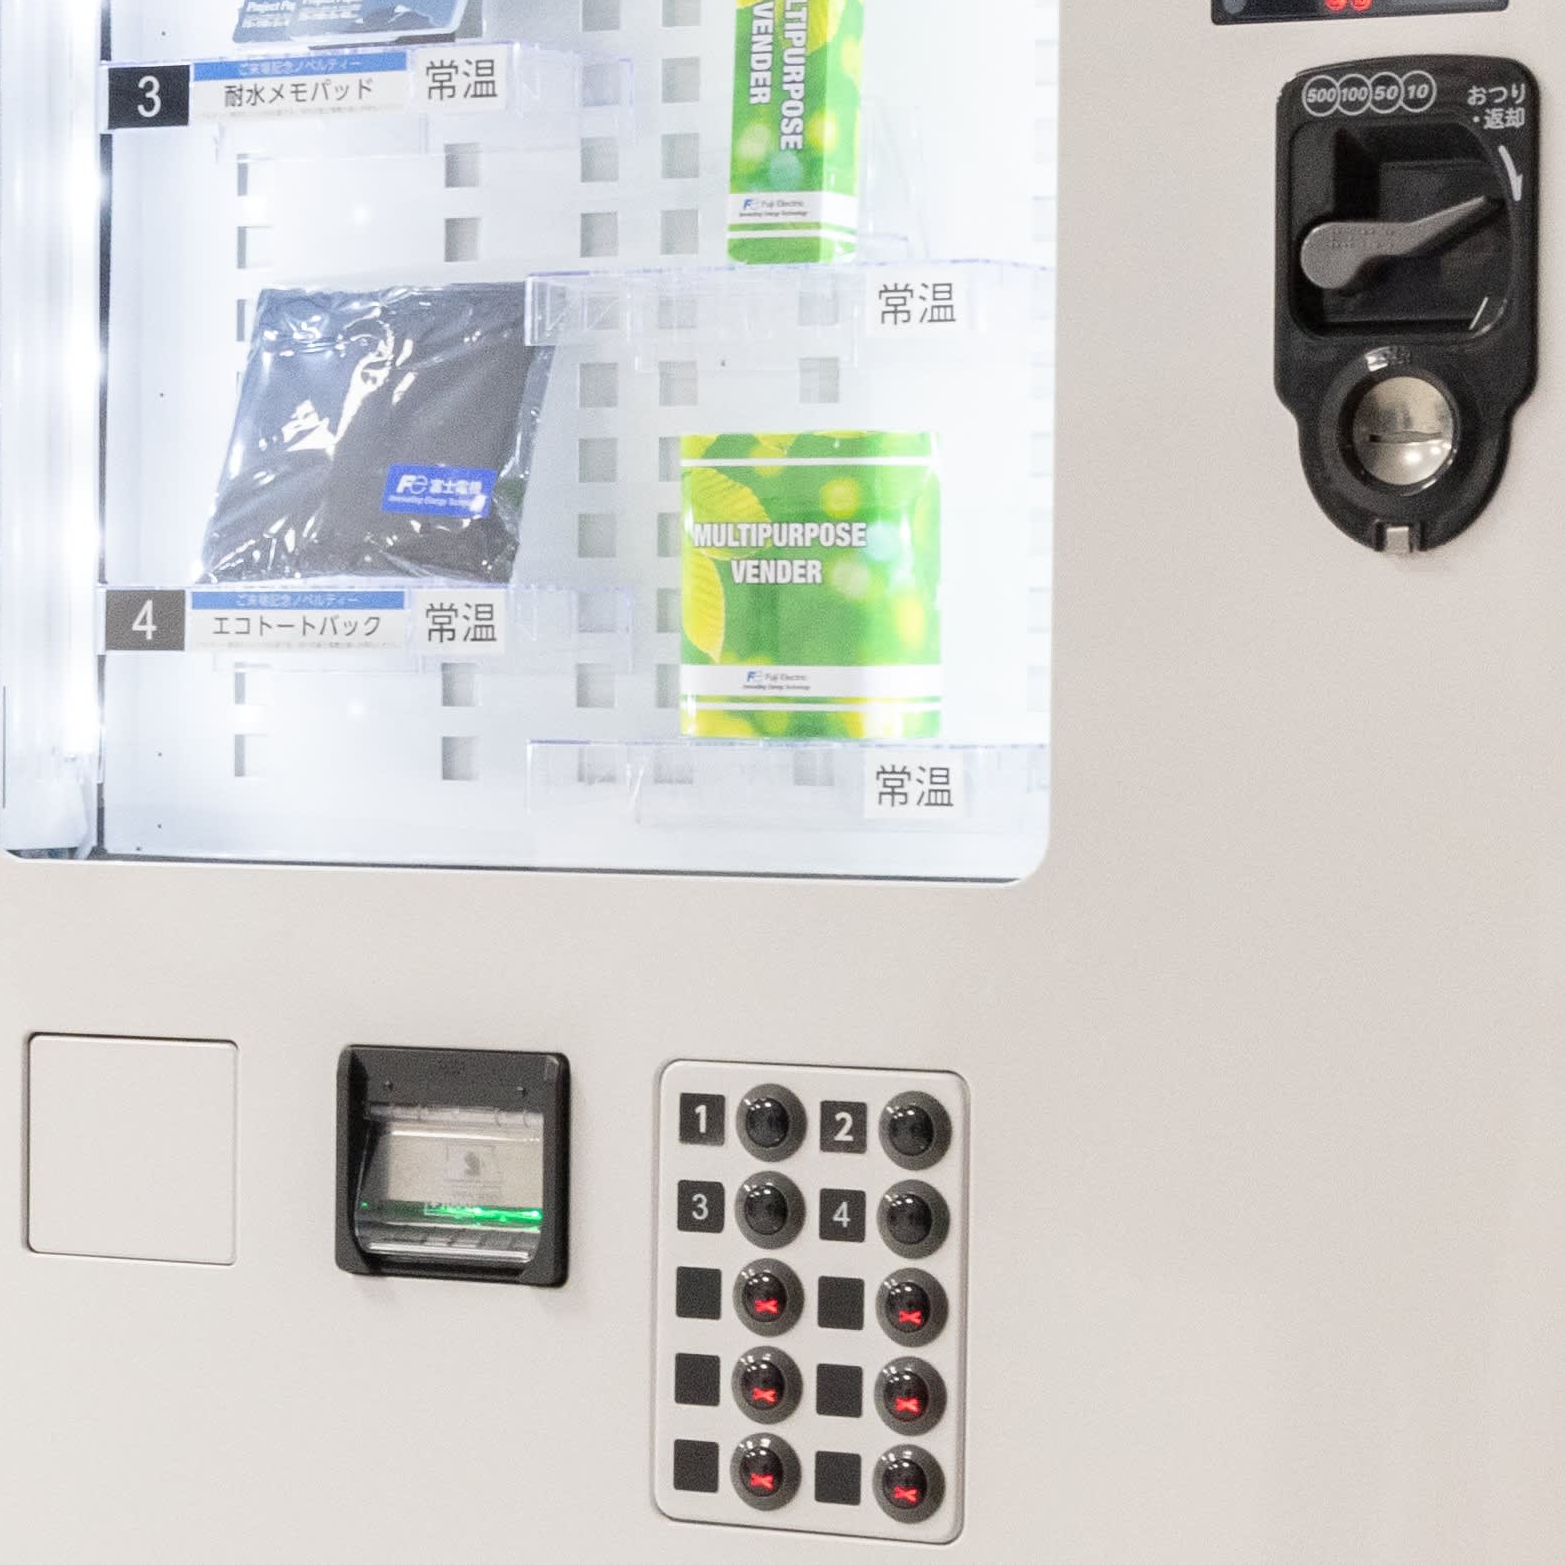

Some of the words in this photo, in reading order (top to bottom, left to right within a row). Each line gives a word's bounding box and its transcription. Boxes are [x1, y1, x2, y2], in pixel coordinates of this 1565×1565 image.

[748, 0, 776, 105] VENDER
[224, 77, 374, 109] 耐水メモパッド
[425, 58, 499, 101] 常温
[1306, 86, 1337, 103] 500
[1340, 85, 1368, 102] 100
[1374, 84, 1399, 101] 50
[1406, 83, 1430, 100] 10
[1466, 82, 1527, 106] おつり
[137, 75, 162, 118] 3
[776, 198, 805, 209] Electric
[878, 282, 957, 326] 常温
[693, 521, 868, 548] MULTIPURPOSE
[730, 559, 823, 584] VENDER
[131, 598, 157, 640] 4
[213, 614, 382, 638] エコトートバック
[424, 602, 498, 644] 常温
[779, 673, 807, 682] Electric
[875, 764, 954, 808] 常温
[694, 1104, 708, 1134] 1
[834, 1112, 854, 1142] 2
[691, 1193, 709, 1221] 3
[832, 1201, 851, 1228] 4
